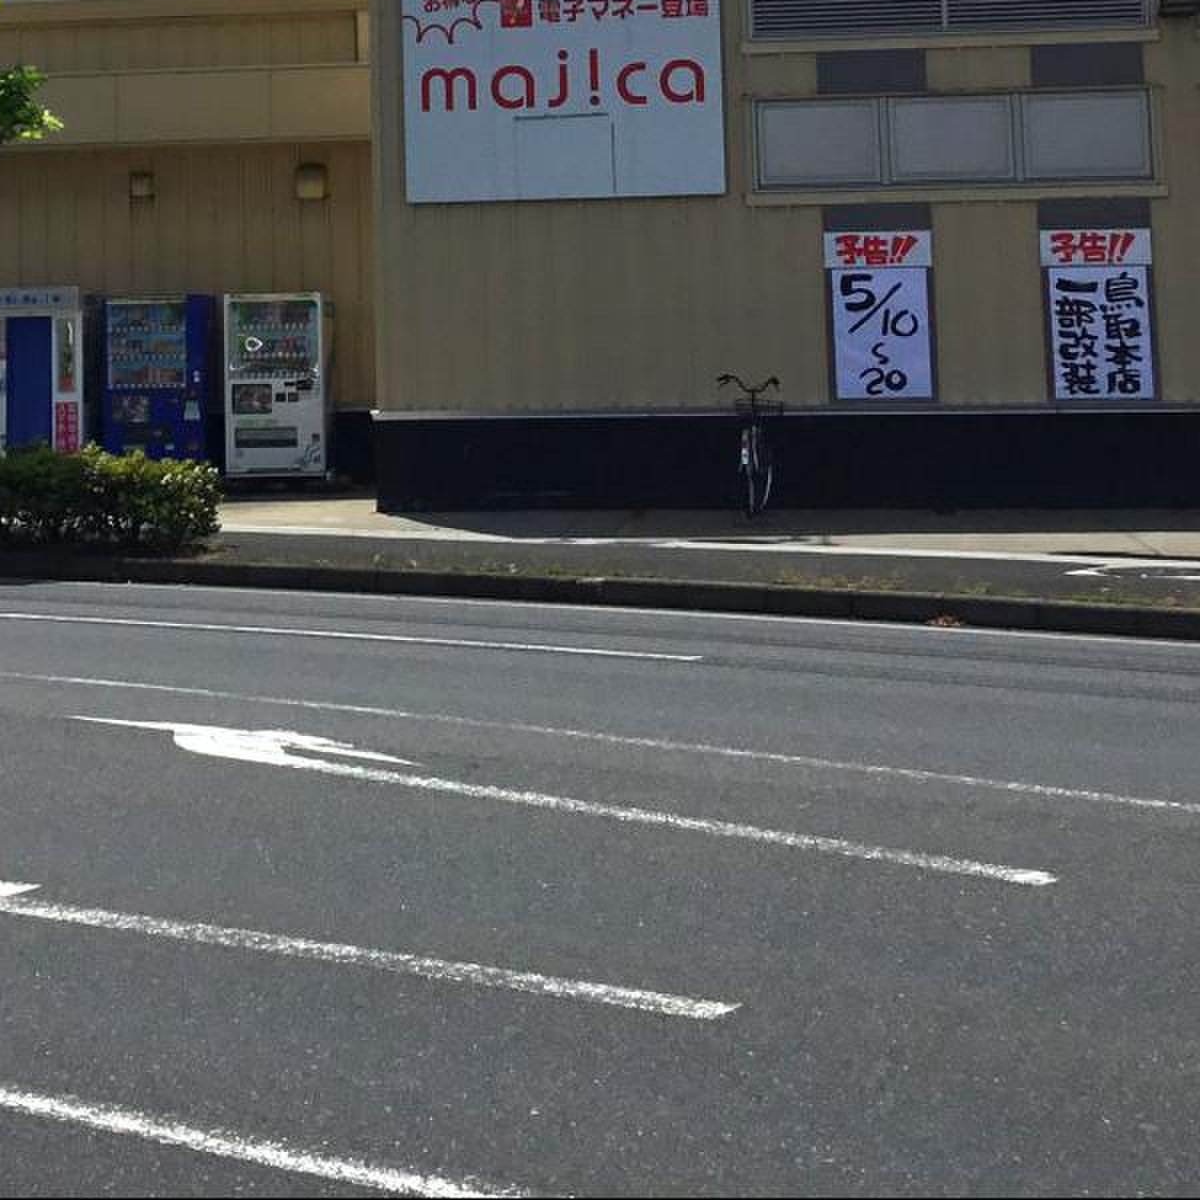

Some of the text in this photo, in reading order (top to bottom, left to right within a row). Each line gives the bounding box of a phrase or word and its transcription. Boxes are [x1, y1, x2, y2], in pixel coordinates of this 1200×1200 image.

[840, 273, 919, 338] 5/10
[1055, 277, 1100, 396] 一部改装
[1100, 271, 1145, 395] 鳥取本店
[859, 367, 908, 396] 20
